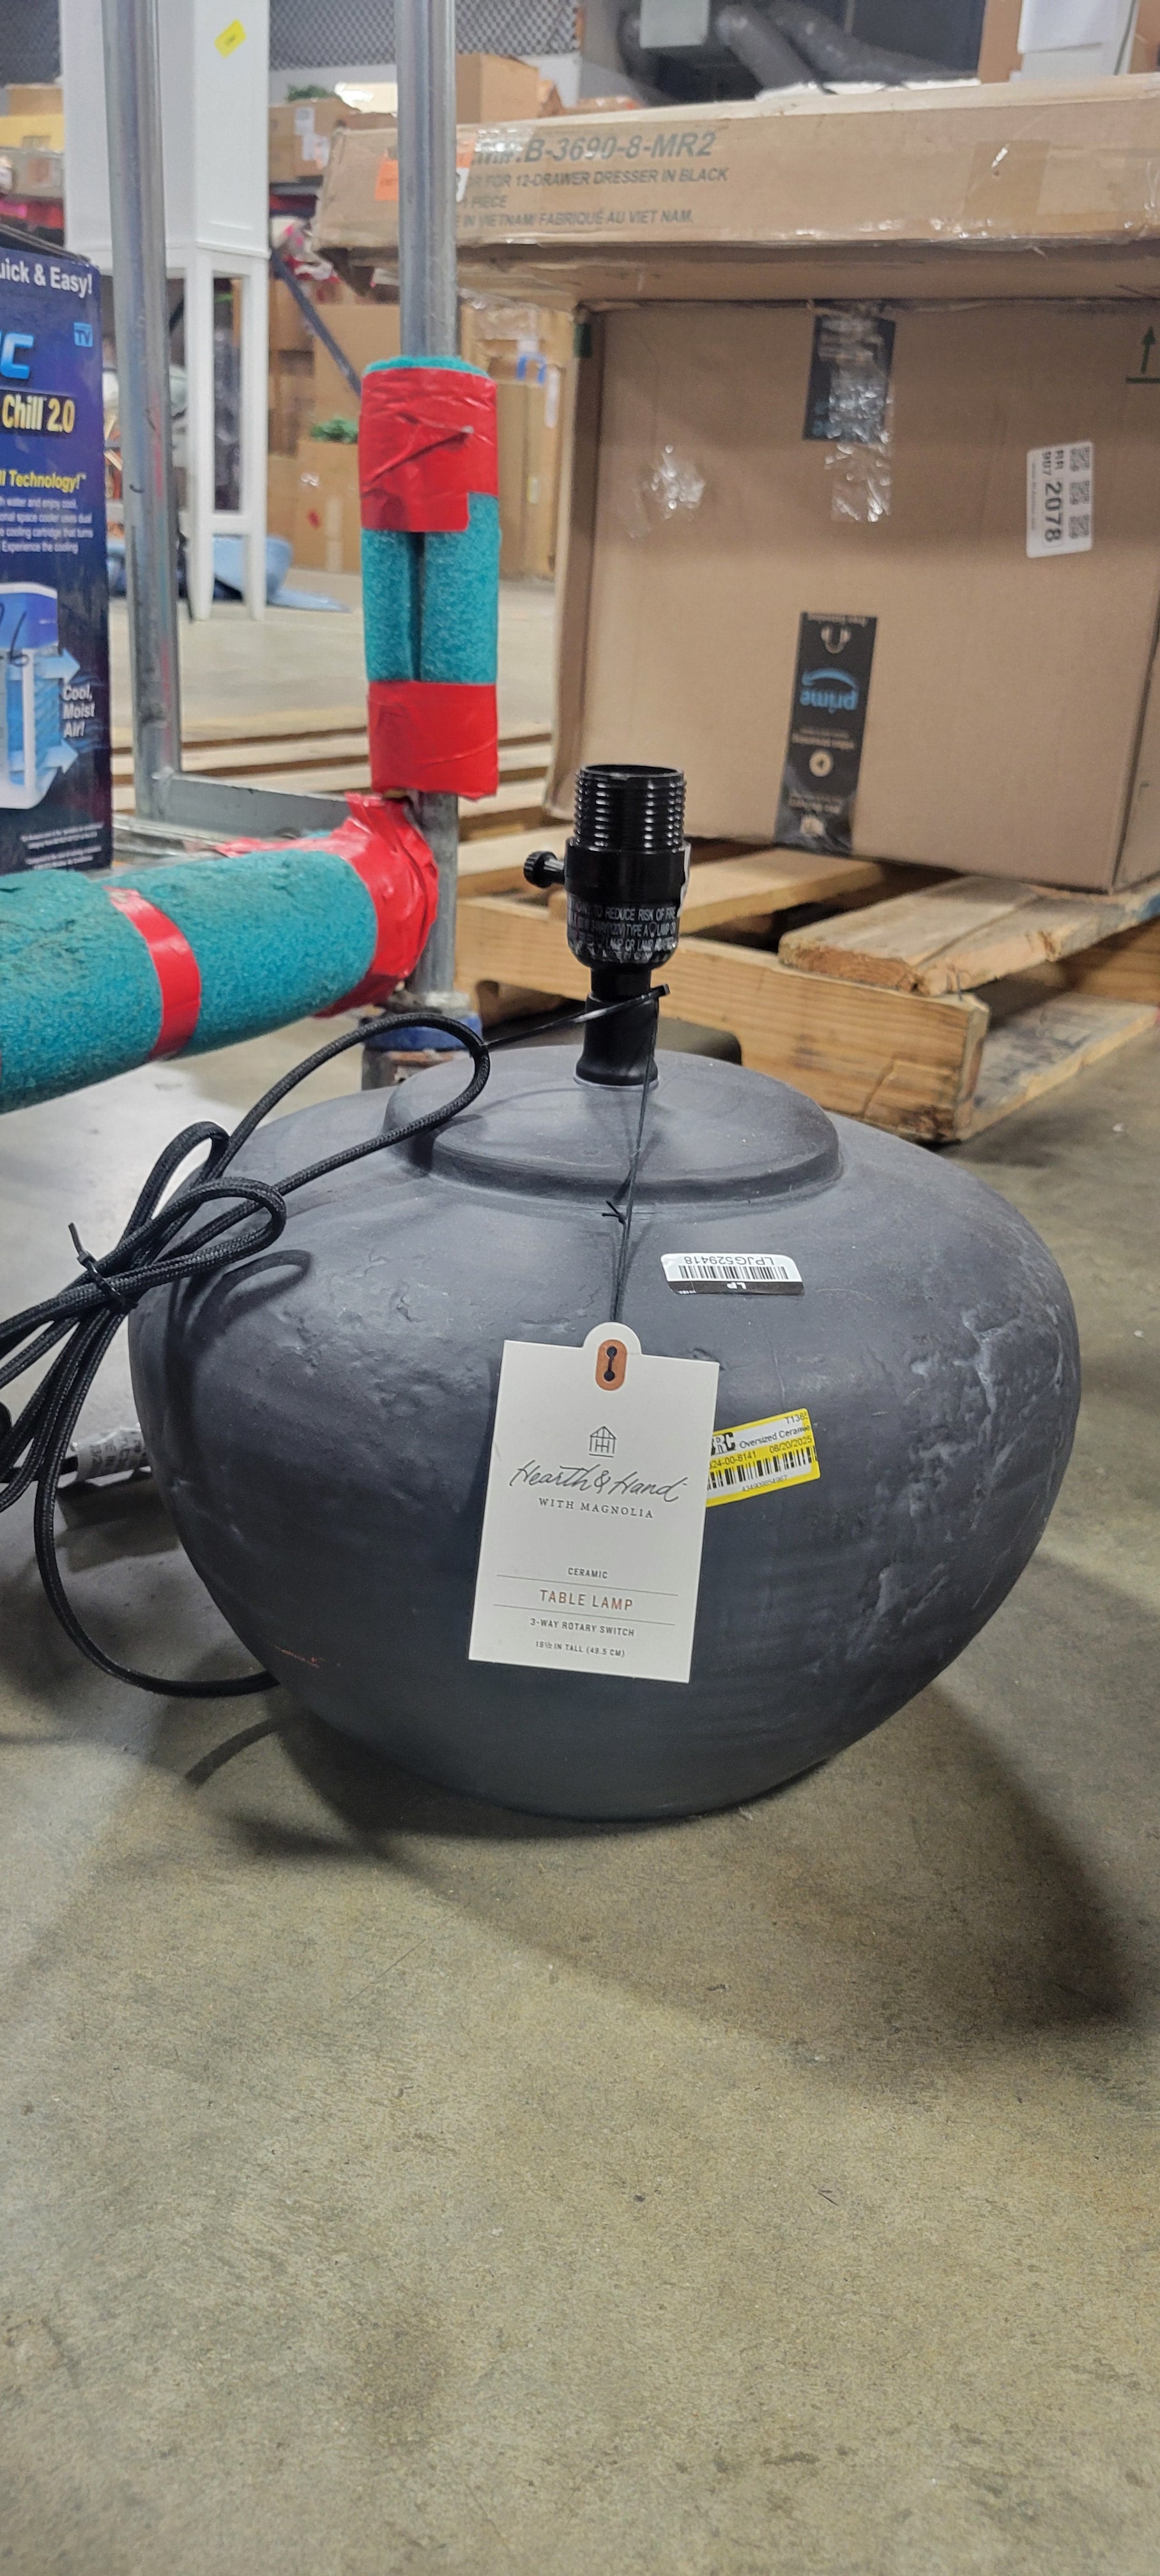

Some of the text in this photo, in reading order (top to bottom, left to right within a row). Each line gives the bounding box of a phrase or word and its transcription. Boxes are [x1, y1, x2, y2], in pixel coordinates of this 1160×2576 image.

[516, 171, 589, 187] 12-DRAWER
[593, 169, 658, 184] DRESSER
[662, 169, 675, 183] IN
[679, 167, 728, 182] BLACK
[607, 211, 625, 224] AU
[629, 210, 657, 224] VIET
[34, 263, 46, 286] &
[50, 266, 92, 299] Easy!
[0, 330, 34, 379] C
[47, 397, 75, 433] 2.0
[1044, 481, 1063, 542] 2078
[63, 703, 95, 719] Moist
[65, 721, 85, 738] Air!
[606, 907, 635, 921] REDUCE
[638, 908, 653, 921] RISK
[656, 908, 664, 921] OF
[626, 924, 643, 937] TYPE
[643, 924, 648, 937] A
[625, 939, 635, 951] OR
[683, 1255, 775, 1266] LPJG529418
[727, 1282, 747, 1290] LP
[739, 1433, 777, 1448] Oversized
[709, 1435, 813, 1469] 24-00-8141 08/20/2025
[509, 1459, 689, 1502] Hearth & Hand
[538, 1497, 653, 1519] WITH MAGNOLIA
[568, 1567, 608, 1579] CERAMIC
[540, 1589, 633, 1611] TABLE LAMP
[530, 1618, 635, 1637] 3-WAY ROTARY SWITCH
[565, 1643, 583, 1653] TALL
[609, 1648, 625, 1658] CM)
